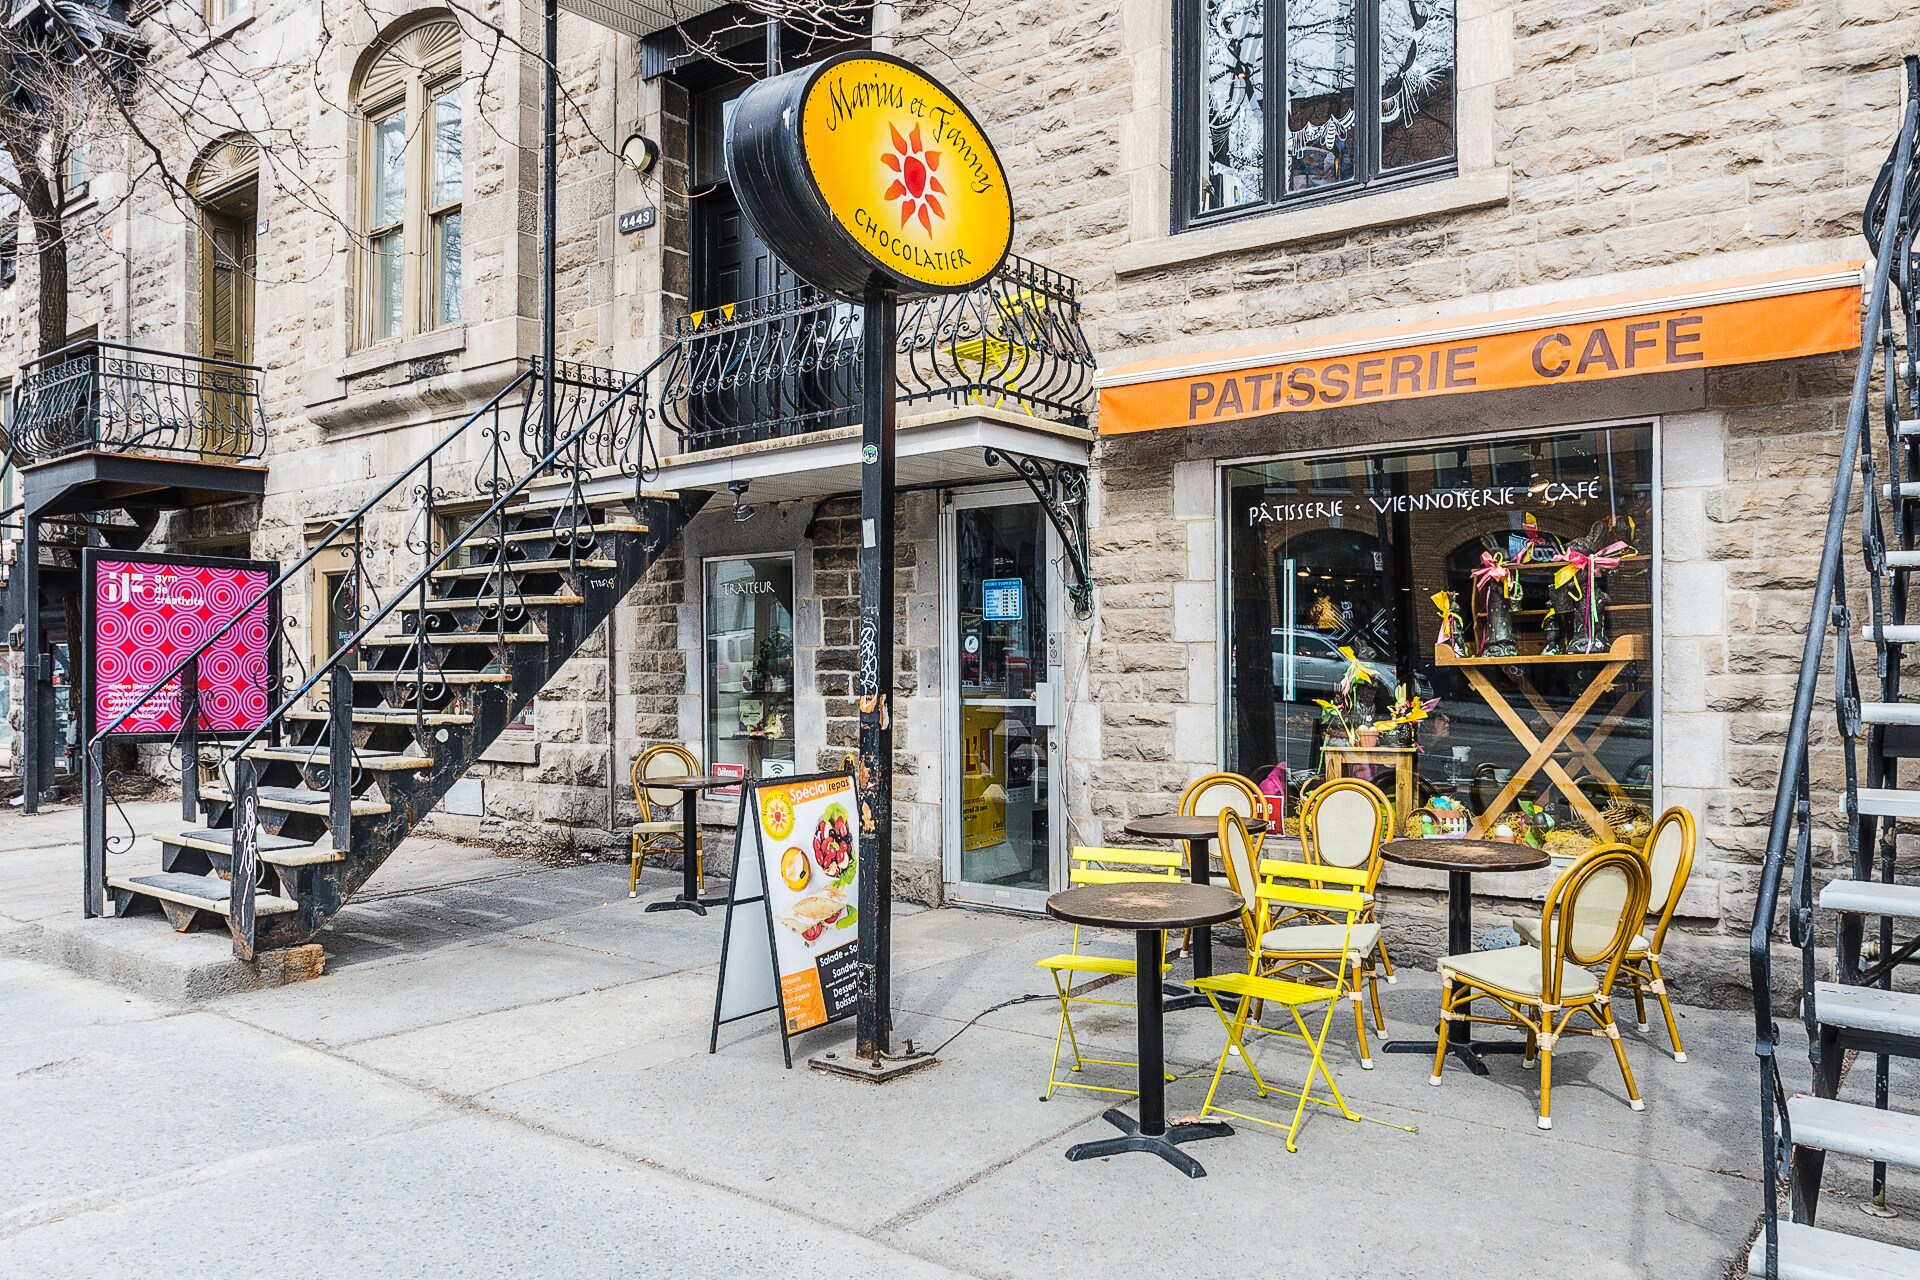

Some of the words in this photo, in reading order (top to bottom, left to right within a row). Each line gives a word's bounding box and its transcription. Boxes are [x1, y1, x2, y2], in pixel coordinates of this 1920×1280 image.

[826, 73, 903, 131] Marius
[910, 97, 927, 118] et
[929, 107, 993, 193] Fanny
[621, 210, 650, 229] 4443
[854, 208, 972, 271] CHOCOLATIER
[1189, 345, 1478, 421] PATISSERIE
[1531, 313, 1705, 379] CAFÉ
[1248, 500, 1344, 527] PÂTISSERIE
[1544, 475, 1600, 502] CAFÉ
[154, 573, 179, 584] gym
[722, 580, 776, 596] TRAITEUR
[154, 586, 169, 594] de
[154, 596, 205, 606] créativité
[789, 780, 828, 804] Spécial
[828, 779, 850, 792] repas
[820, 950, 843, 967] Salade
[833, 979, 857, 998] Dessert
